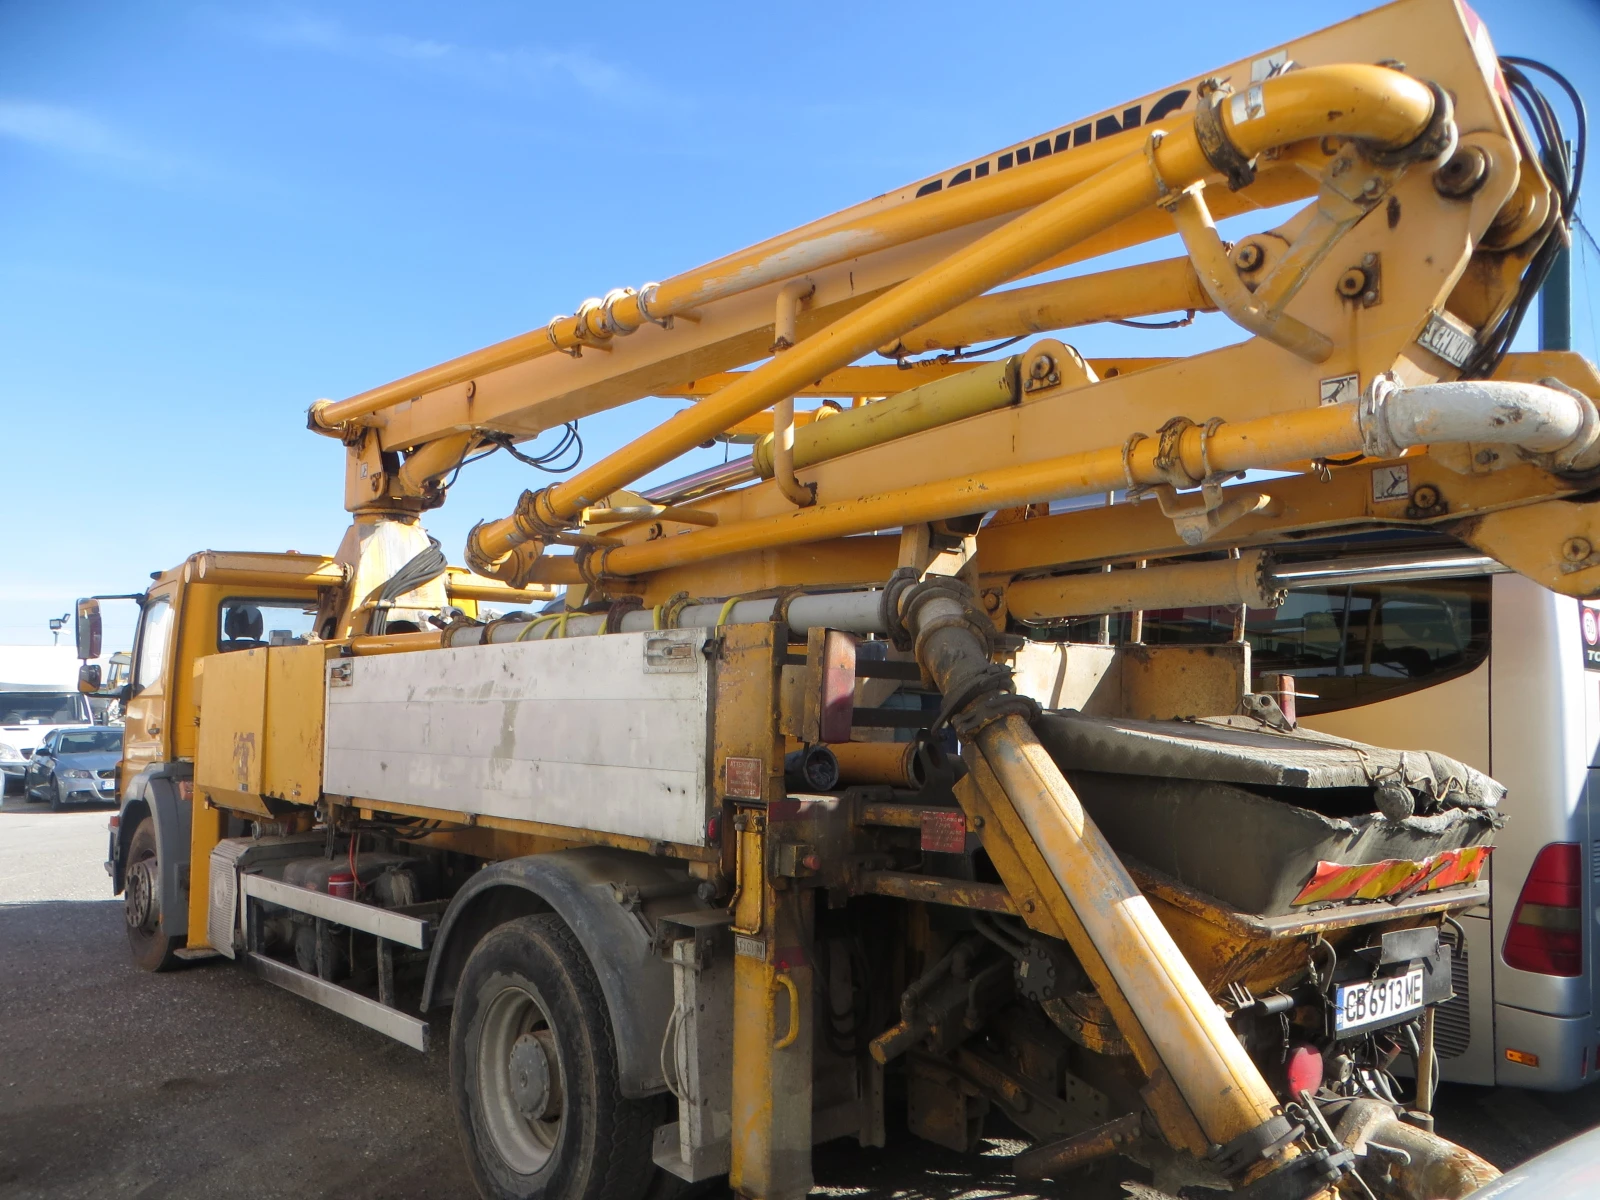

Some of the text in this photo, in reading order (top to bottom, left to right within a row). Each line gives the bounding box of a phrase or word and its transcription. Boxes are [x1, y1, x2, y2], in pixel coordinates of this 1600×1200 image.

[1346, 975, 1421, 1022] CB 6913 ME
